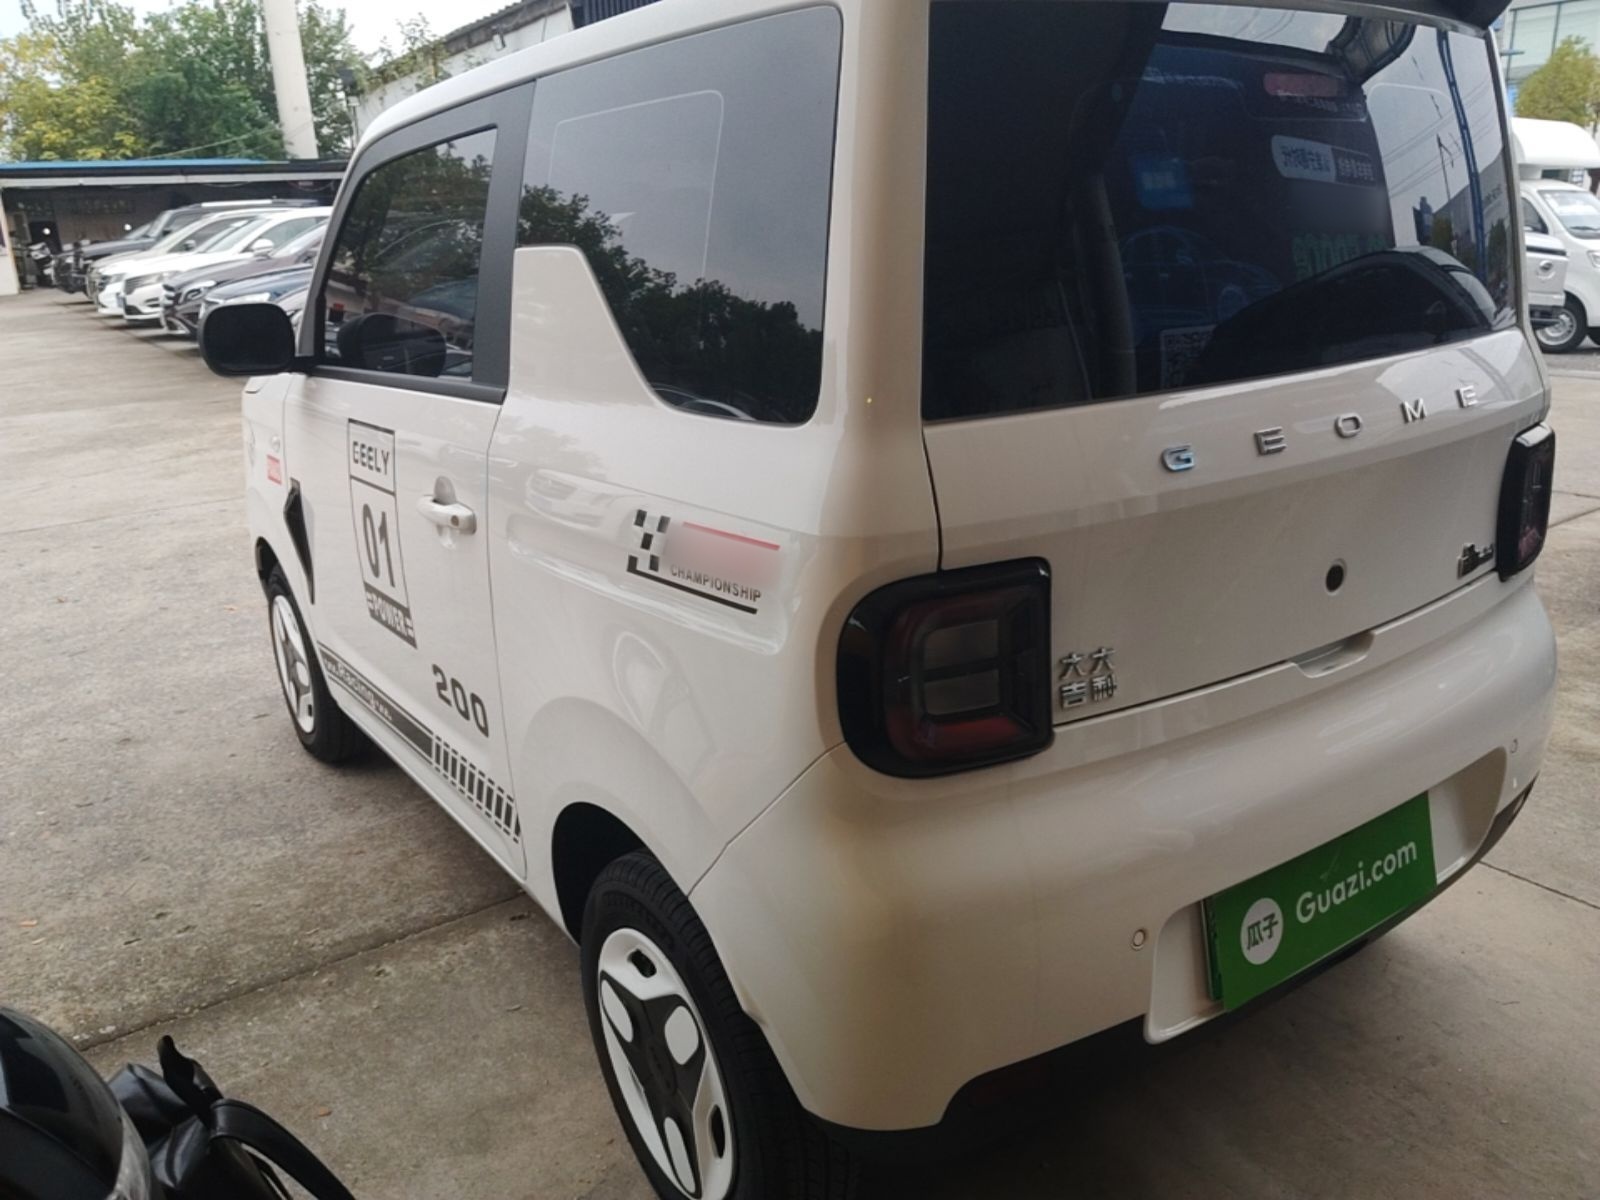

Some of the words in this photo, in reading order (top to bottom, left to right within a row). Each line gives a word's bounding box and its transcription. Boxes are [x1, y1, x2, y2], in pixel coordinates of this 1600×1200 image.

[352, 441, 390, 476] GEELY
[1161, 384, 1479, 472] GEOME
[361, 503, 396, 588] 01
[670, 563, 762, 603] CHAMPIONSHIP
[431, 663, 490, 739] 200
[1296, 841, 1418, 924] Guazi.com
[1246, 912, 1280, 951] 瓜子
